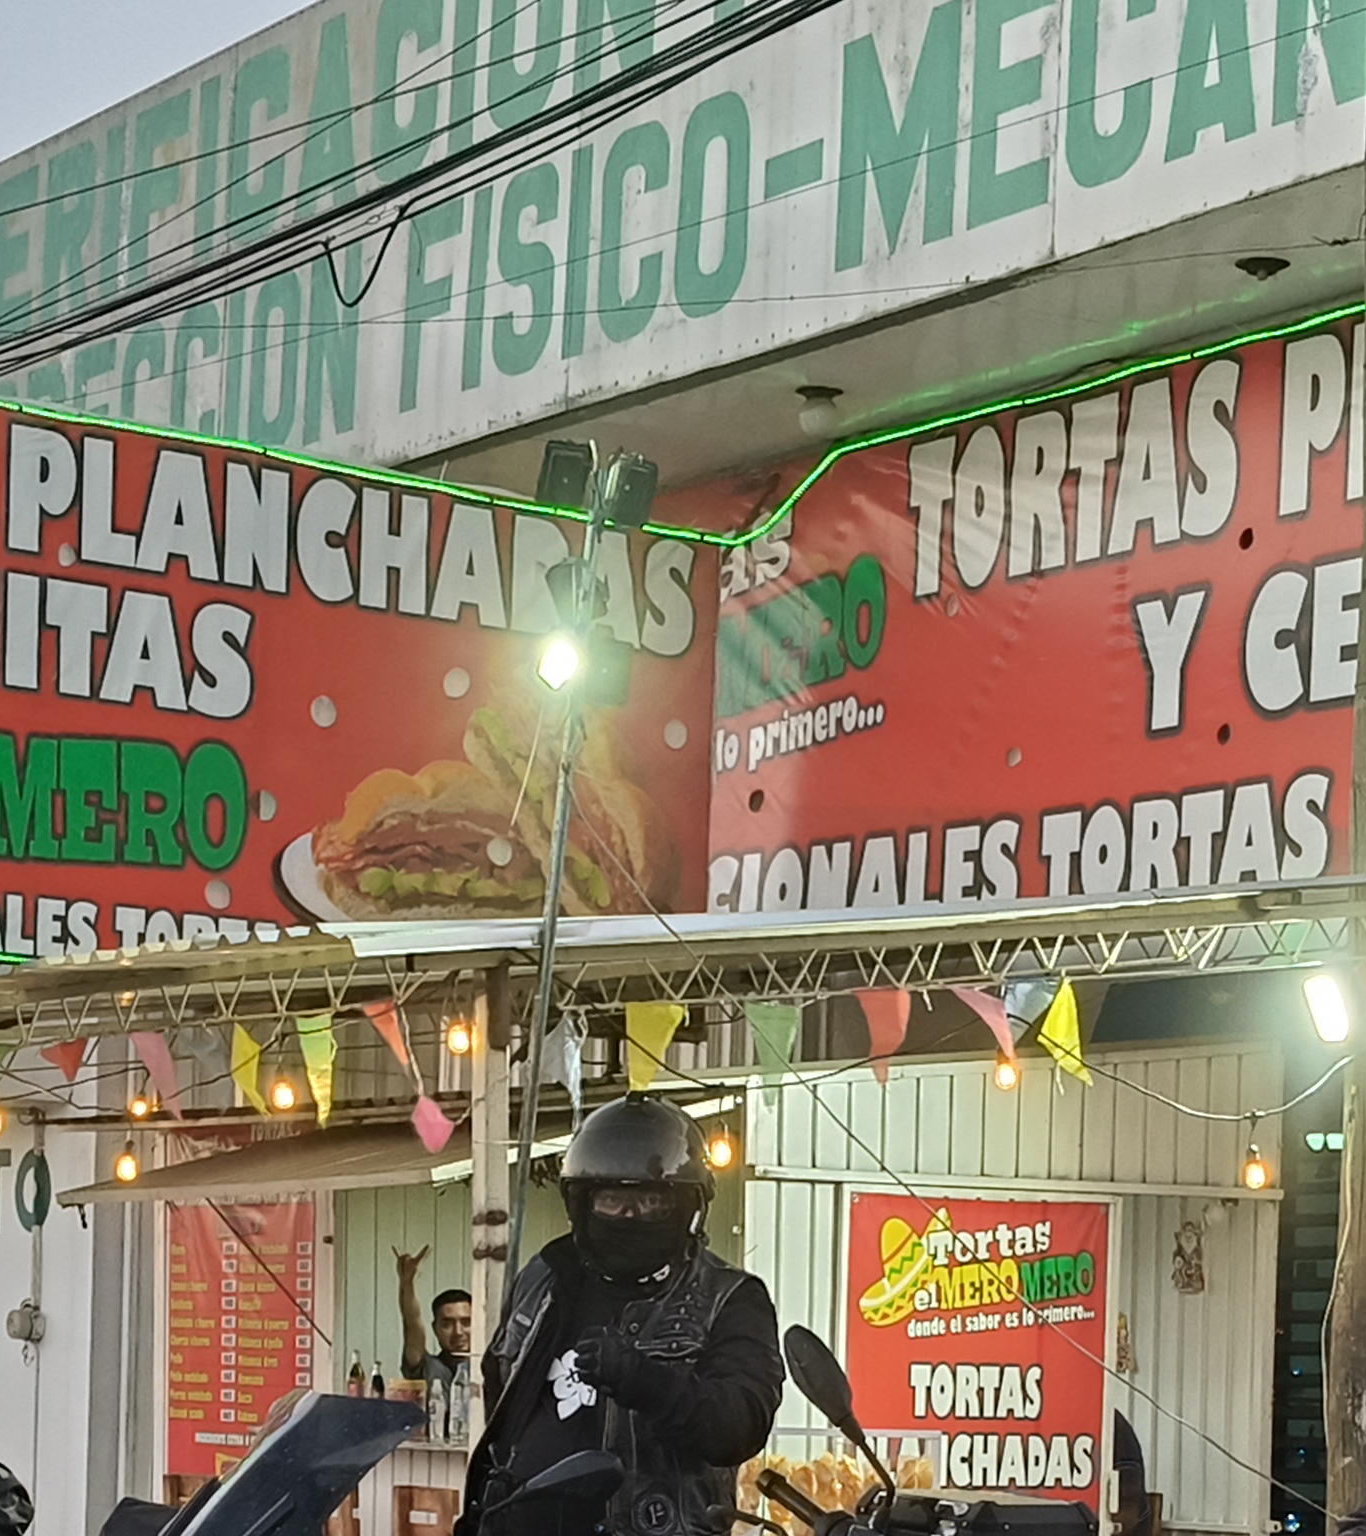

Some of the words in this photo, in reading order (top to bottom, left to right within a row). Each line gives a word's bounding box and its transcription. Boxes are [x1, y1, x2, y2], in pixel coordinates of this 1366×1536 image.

[908, 359, 1240, 598] TORTAS
[1135, 591, 1206, 732] Y
[1041, 773, 1330, 899] TORTAS
[927, 1219, 1052, 1267] Tortas
[933, 1257, 1020, 1310] MERO
[1020, 1250, 1096, 1304] MERO
[907, 1315, 947, 1339] donde
[950, 1314, 963, 1334] el
[965, 1311, 1002, 1333] sabor
[1005, 1310, 1019, 1329] es
[1022, 1307, 1035, 1327] lo
[909, 1362, 1043, 1420] TORTAS
